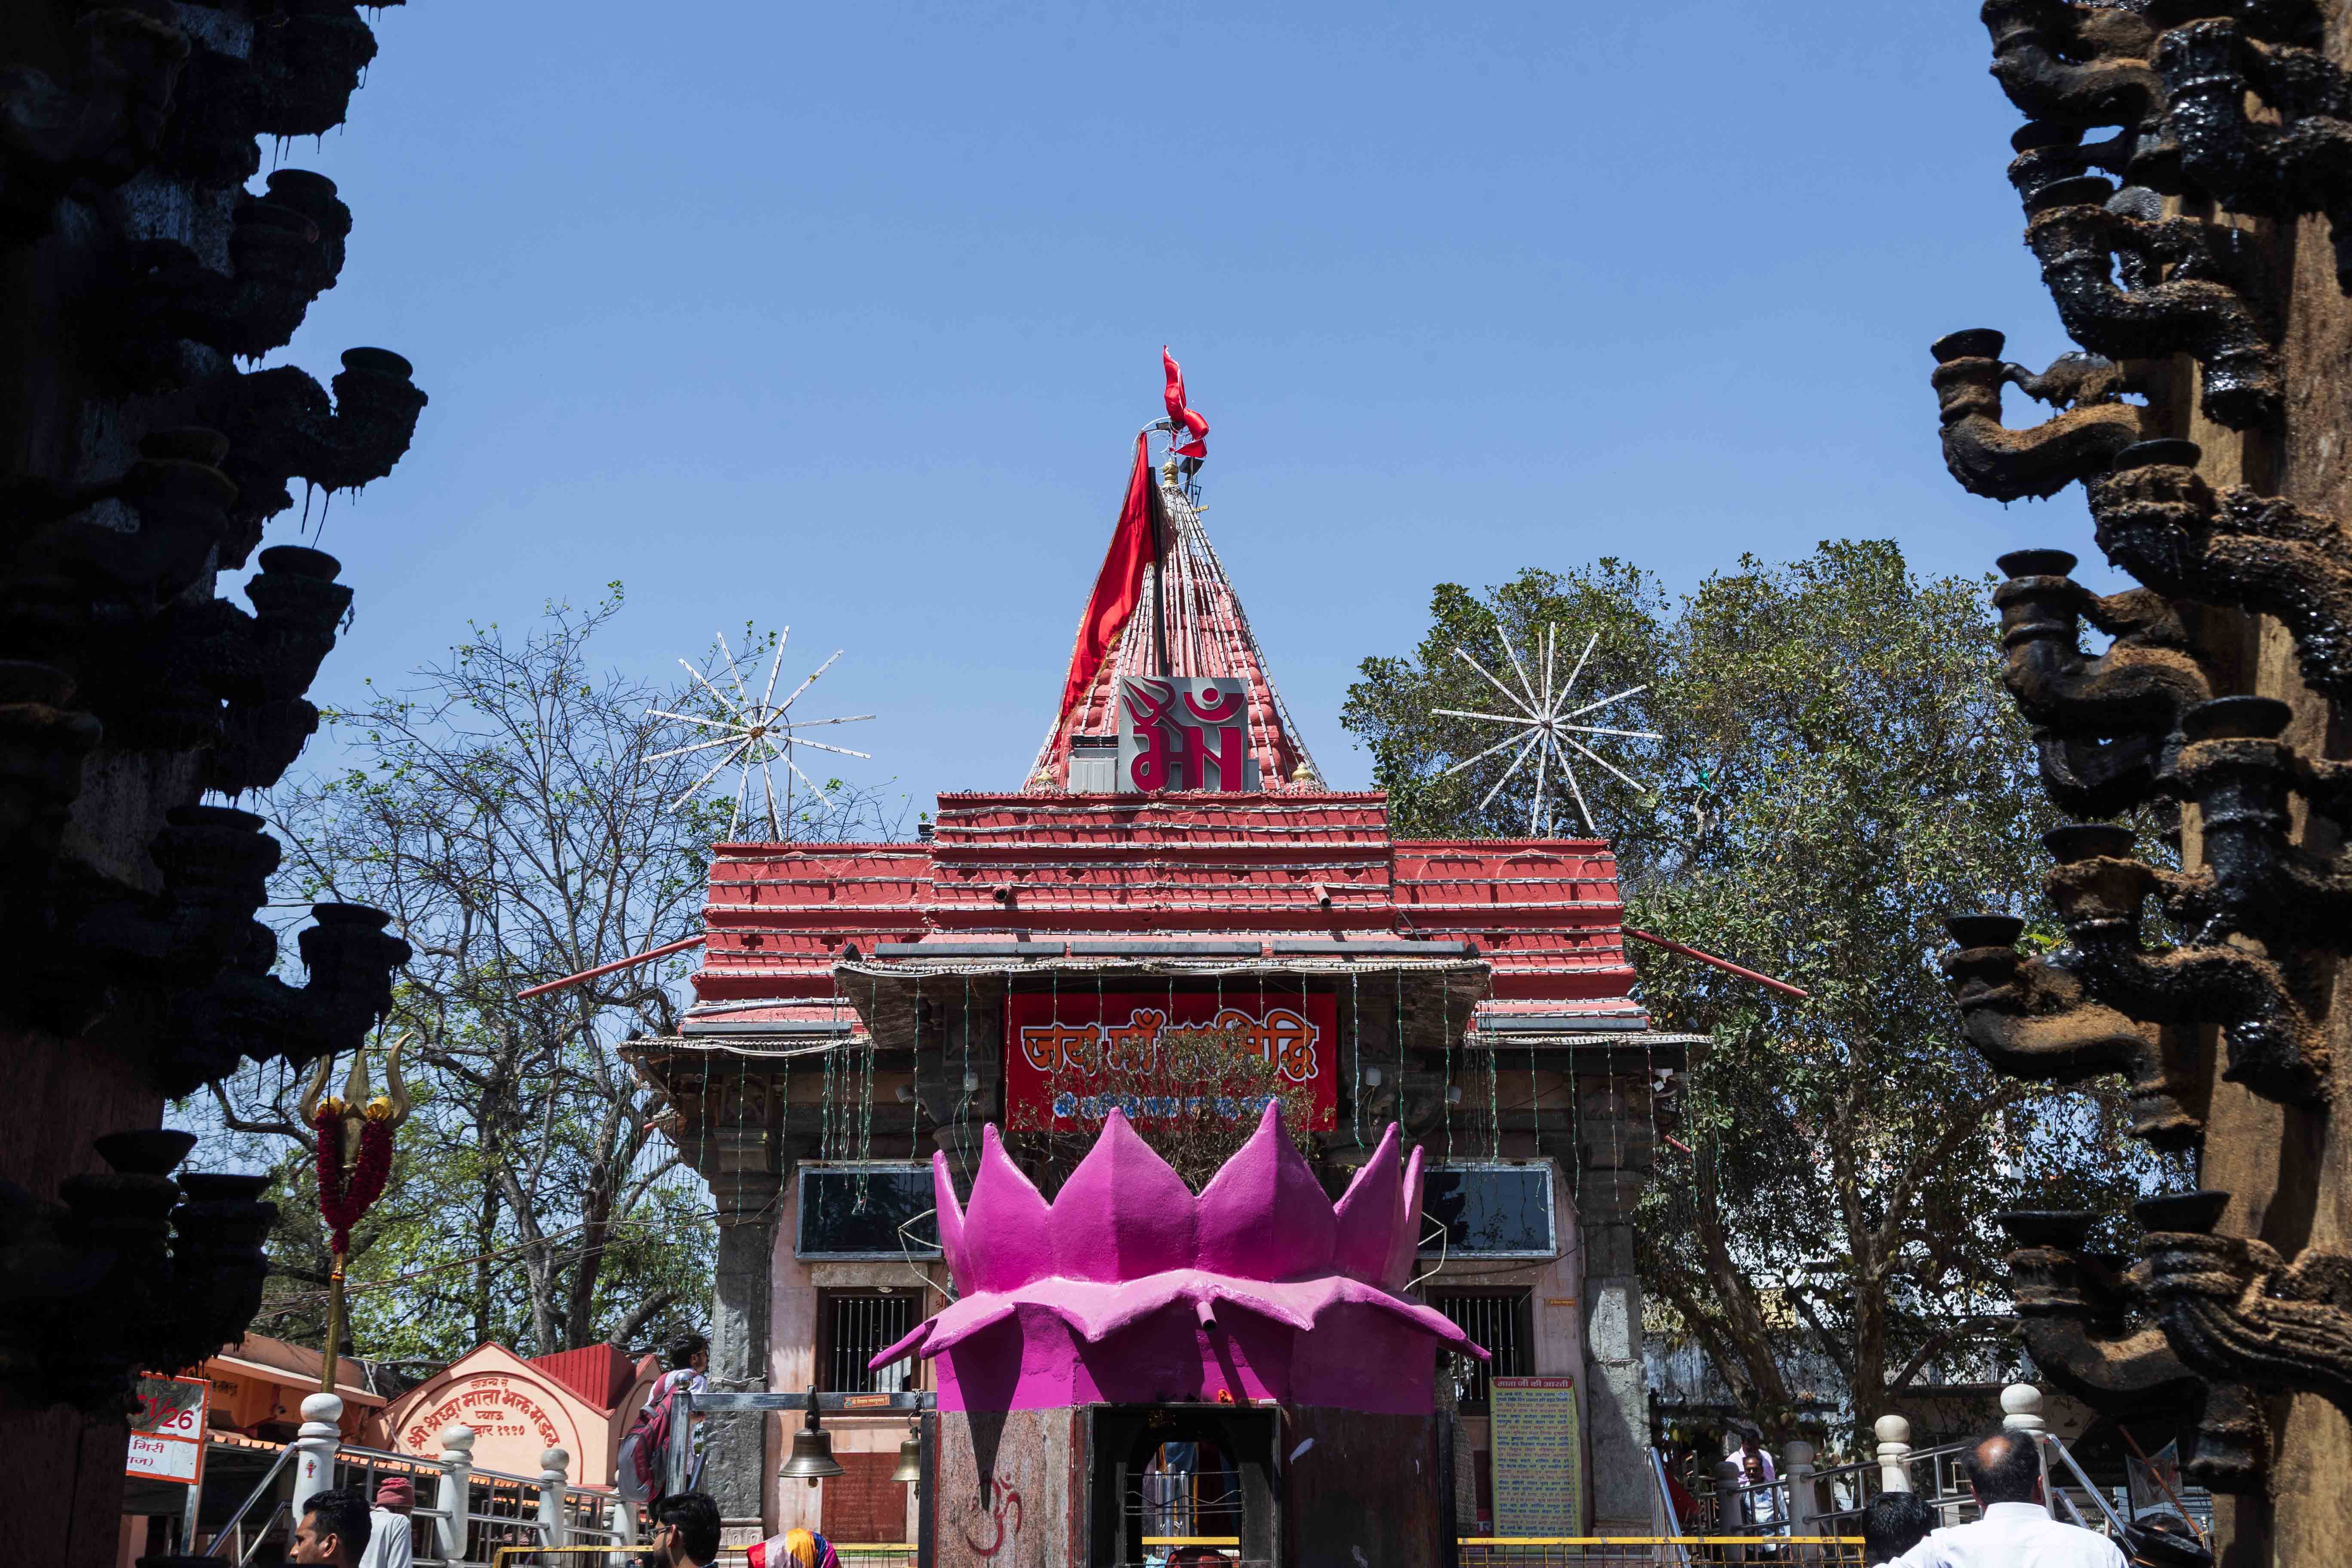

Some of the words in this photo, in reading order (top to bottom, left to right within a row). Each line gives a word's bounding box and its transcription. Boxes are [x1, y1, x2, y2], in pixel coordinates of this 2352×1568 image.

[1020, 1021, 1104, 1075] जय
[1530, 1379, 1542, 1387] की
[1544, 1379, 1568, 1387] आरती
[407, 1425, 431, 1451] श्री
[461, 1389, 501, 1408] माता
[502, 1388, 533, 1415] भक्त
[475, 1411, 504, 1421] प्याऊ
[132, 1439, 165, 1454] गिरी
